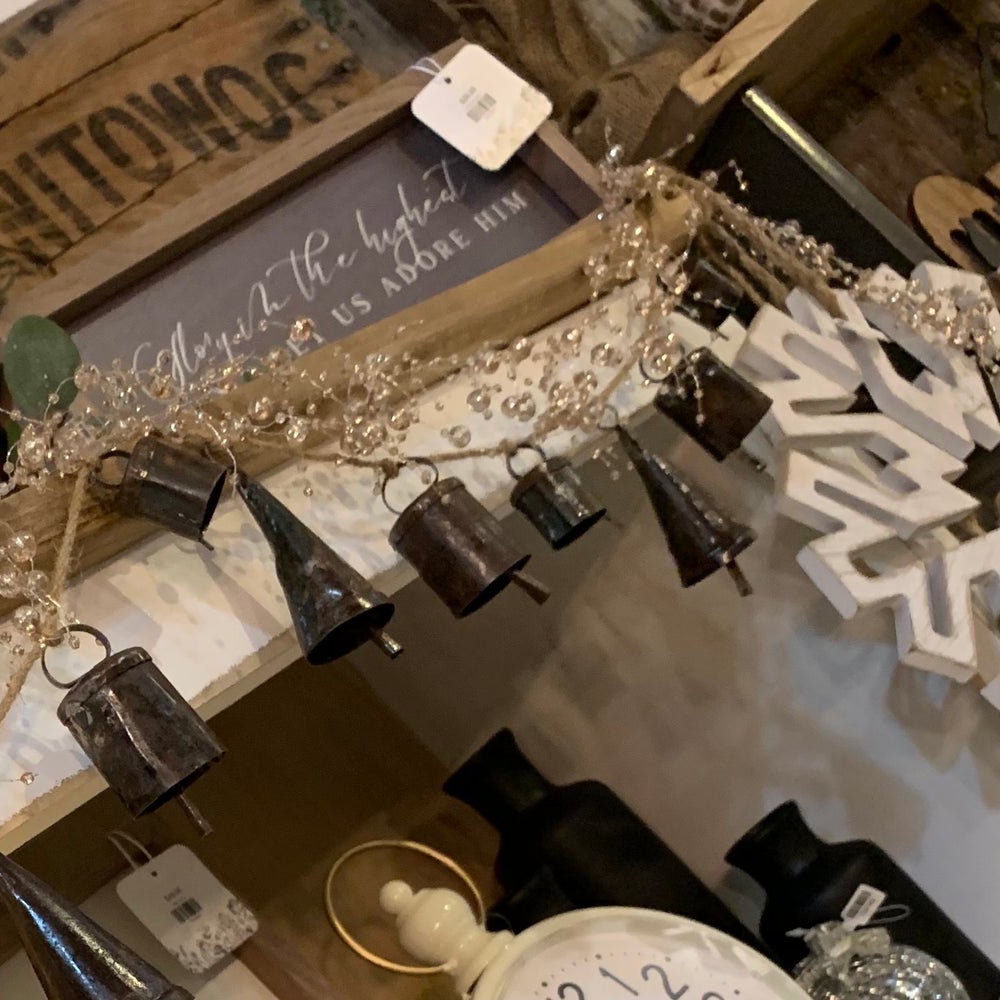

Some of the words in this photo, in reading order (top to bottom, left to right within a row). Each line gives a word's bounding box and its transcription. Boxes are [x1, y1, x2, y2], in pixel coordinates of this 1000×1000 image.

[265, 228, 361, 303] the
[356, 159, 470, 272] highest
[330, 293, 374, 327] US
[380, 228, 472, 297] ADORE
[473, 189, 529, 232] HIM
[598, 966, 640, 997] 1
